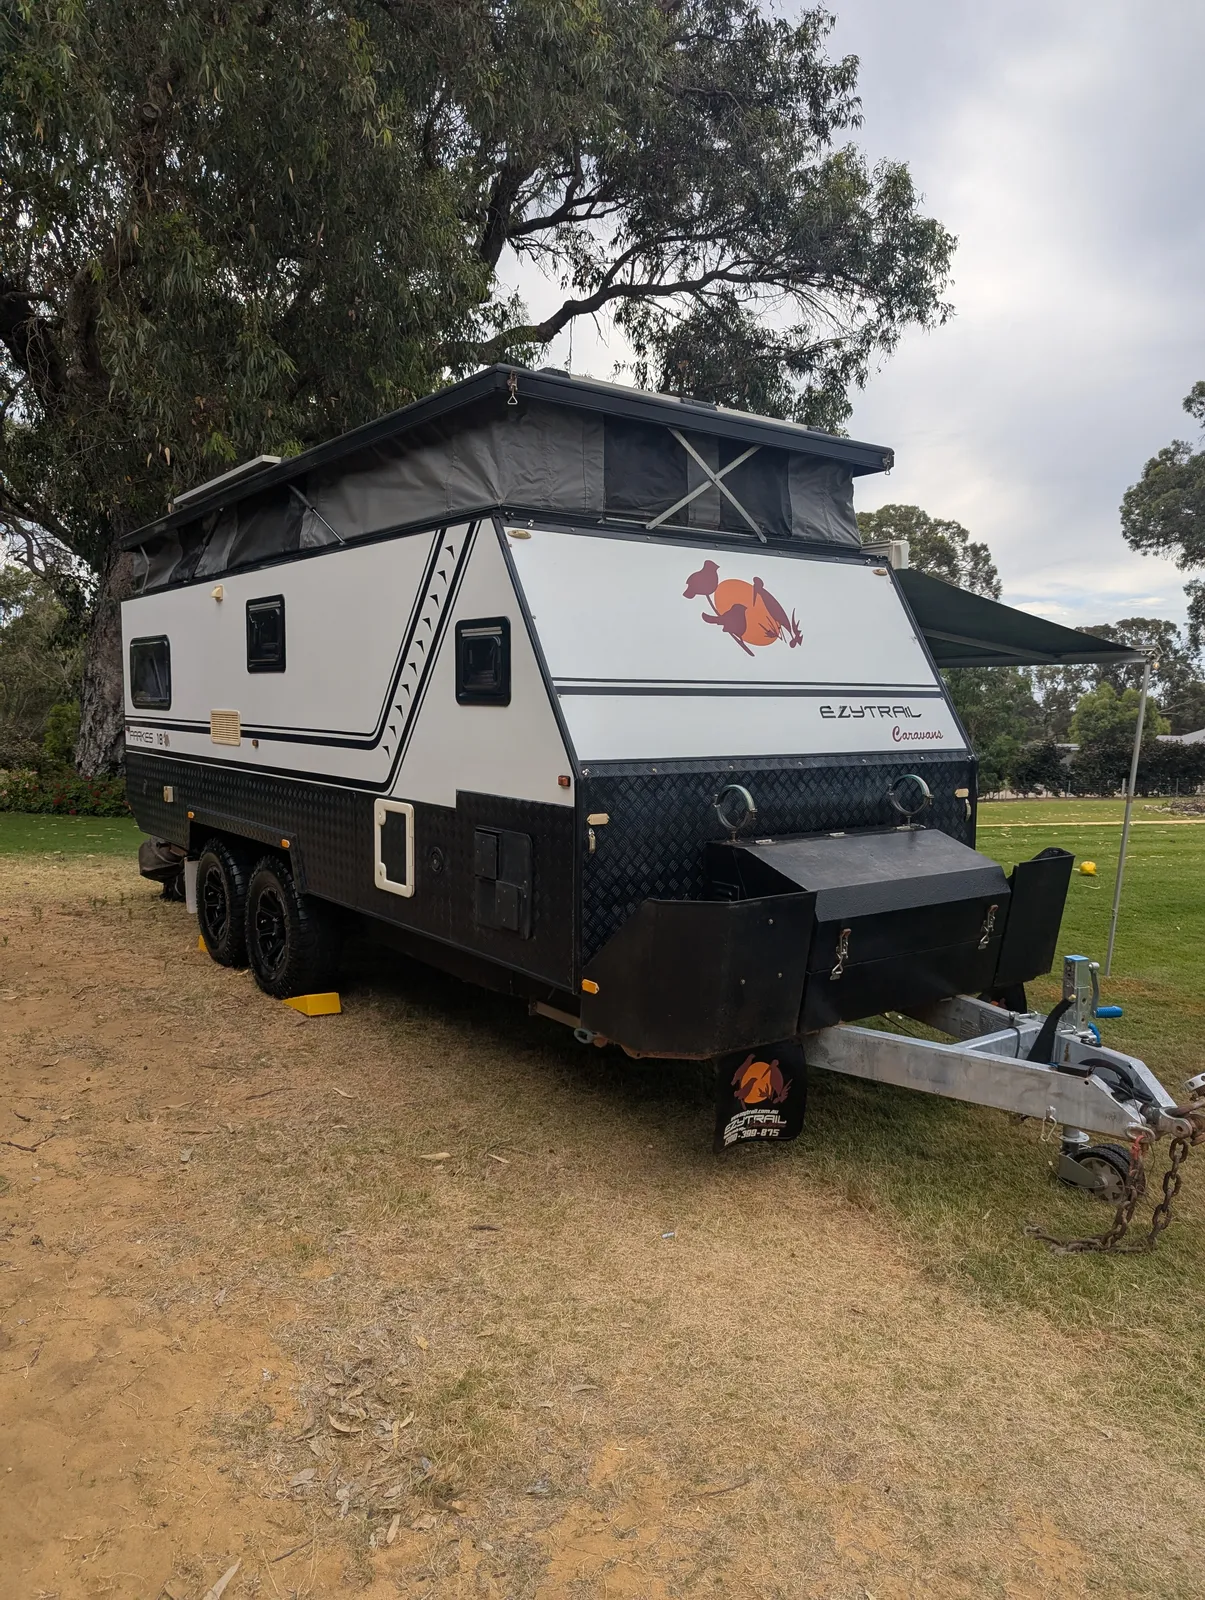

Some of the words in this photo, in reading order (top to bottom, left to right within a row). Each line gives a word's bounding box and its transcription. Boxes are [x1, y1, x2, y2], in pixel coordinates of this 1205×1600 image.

[819, 705, 922, 719] EZYTRAIL
[130, 730, 154, 743] PARKES
[892, 725, 944, 743] Caravans
[724, 1114, 787, 1134] EZYTRAIL
